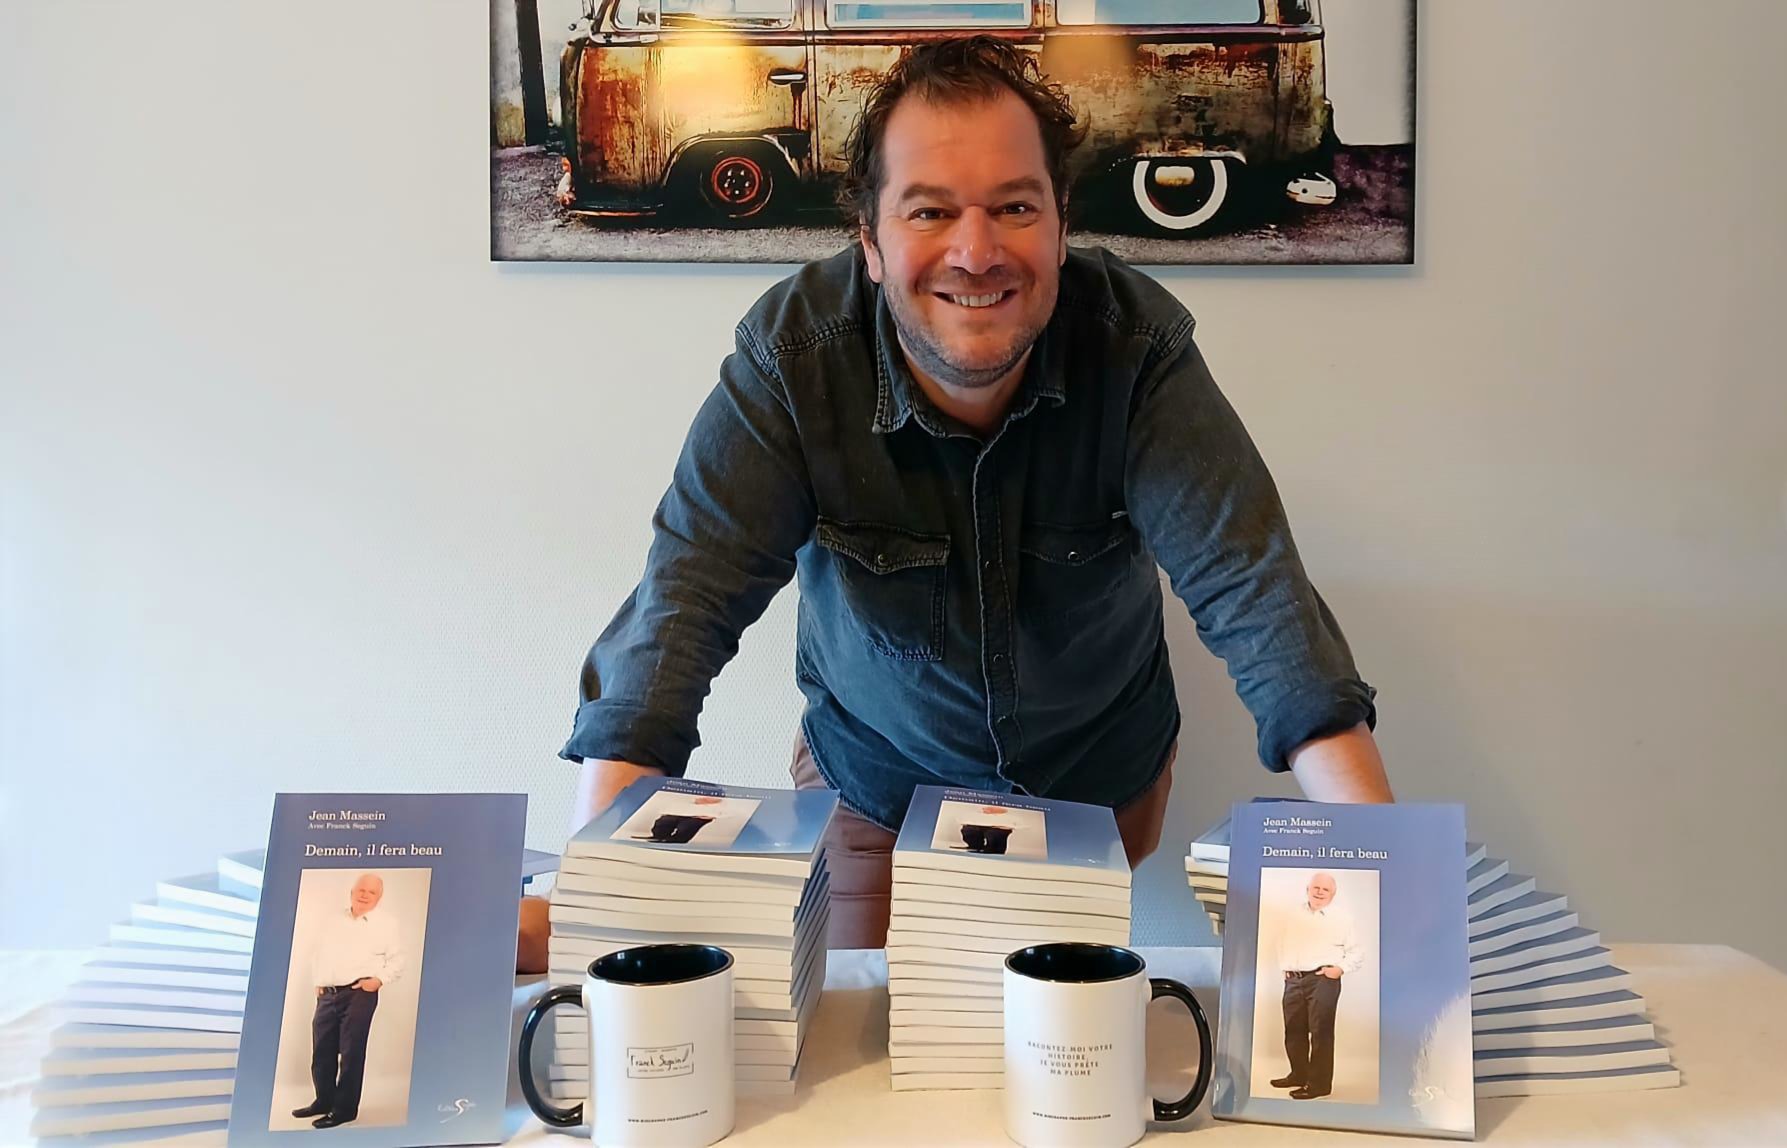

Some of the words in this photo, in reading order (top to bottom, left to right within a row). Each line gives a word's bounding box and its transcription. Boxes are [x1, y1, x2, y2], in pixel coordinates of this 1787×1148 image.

[308, 810, 336, 821] Jean
[340, 810, 386, 821] Massein
[1263, 817, 1287, 827] Jean
[1290, 817, 1332, 827] Massein
[304, 844, 362, 858] Demain,
[366, 843, 376, 856] il
[379, 844, 406, 856] fera
[410, 843, 443, 856] beau
[1263, 846, 1314, 859] Demain,
[1317, 846, 1326, 858] il
[1329, 847, 1355, 858] fera
[1357, 847, 1388, 860] beau
[1088, 1043, 1112, 1052] VOTRE
[1050, 1060, 1072, 1068] VOUS
